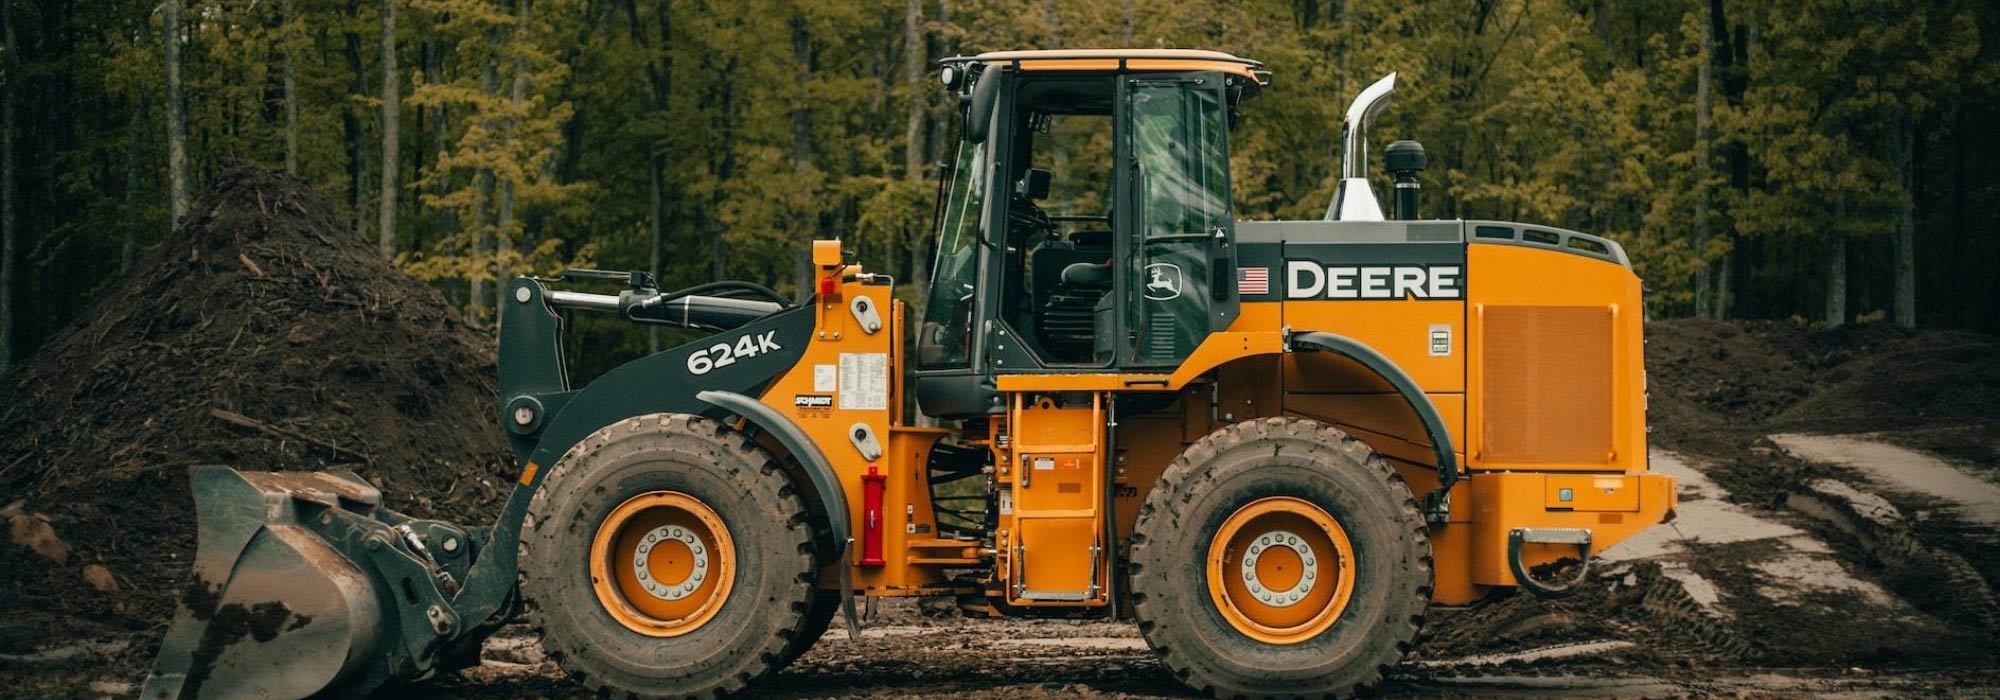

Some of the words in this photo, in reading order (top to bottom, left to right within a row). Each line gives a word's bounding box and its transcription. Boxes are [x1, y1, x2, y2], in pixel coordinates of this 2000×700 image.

[1287, 260, 1460, 298] DEERE
[687, 330, 781, 375] 624K
[795, 396, 832, 407] SCHMIDT
